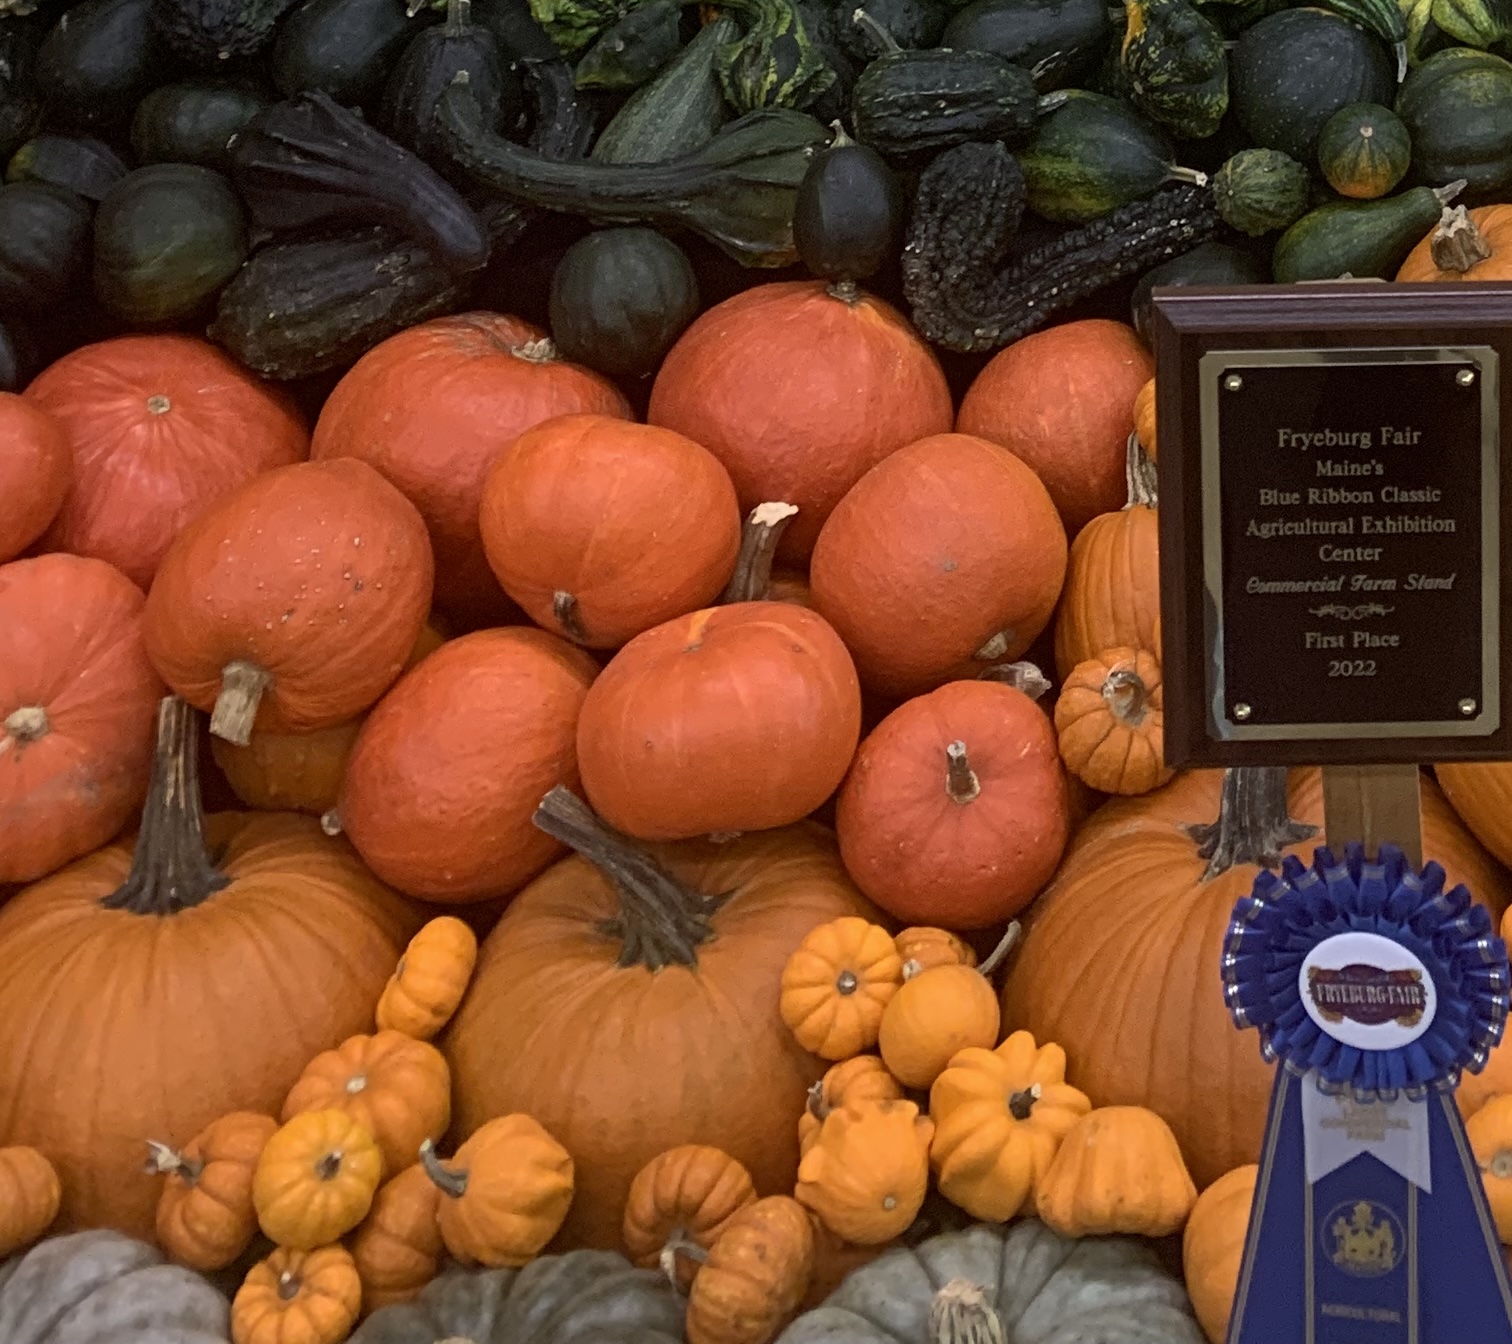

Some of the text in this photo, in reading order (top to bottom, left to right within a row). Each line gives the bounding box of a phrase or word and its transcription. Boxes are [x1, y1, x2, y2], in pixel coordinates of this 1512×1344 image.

[1277, 426, 1422, 451] Fryeburg Fair
[1315, 459, 1384, 477] Maine's
[1259, 486, 1442, 506] Blue Ribbon Classic
[1246, 515, 1456, 538] Agricultural Exhibition
[1318, 544, 1384, 562] Center
[1245, 573, 1457, 594] Commercial Farm Stand
[1304, 631, 1401, 649] First Place
[1327, 660, 1377, 677] 2022
